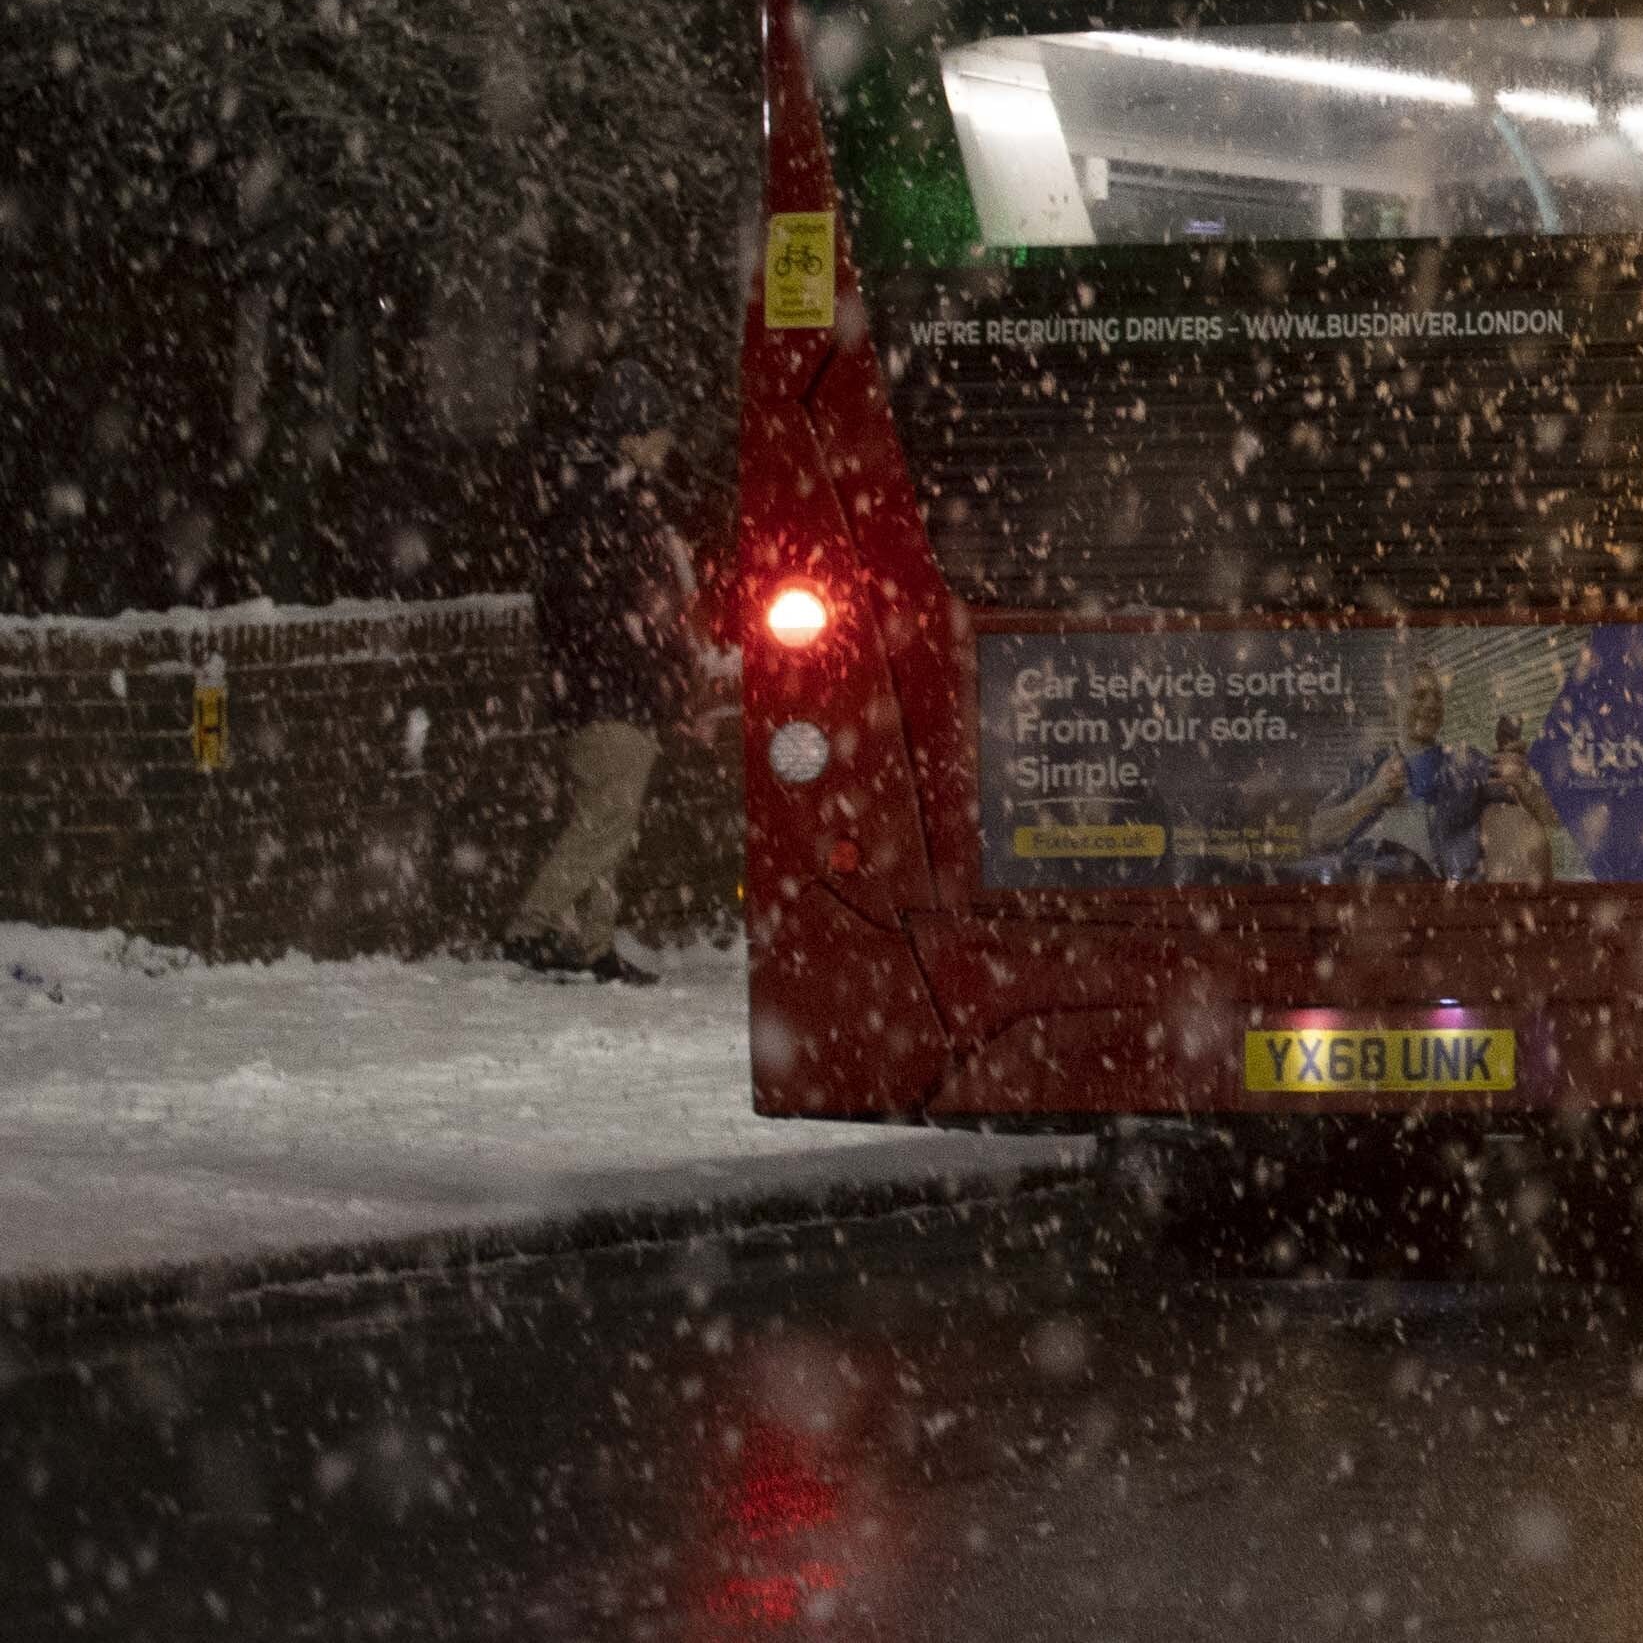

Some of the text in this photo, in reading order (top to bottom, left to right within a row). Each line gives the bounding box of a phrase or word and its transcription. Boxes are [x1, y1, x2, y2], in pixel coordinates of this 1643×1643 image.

[910, 320, 980, 346] WE'RE
[985, 318, 1119, 345] RECRUITING
[1125, 316, 1223, 341] DRIVERS
[1245, 311, 1564, 339] WWW.BUSDRIVER.LONDON
[1015, 663, 1350, 701] Car service sorted.
[1016, 710, 1298, 750] From your sofa.
[1016, 756, 1148, 793] Simple.
[1265, 1036, 1492, 1082] YX68 UNK
